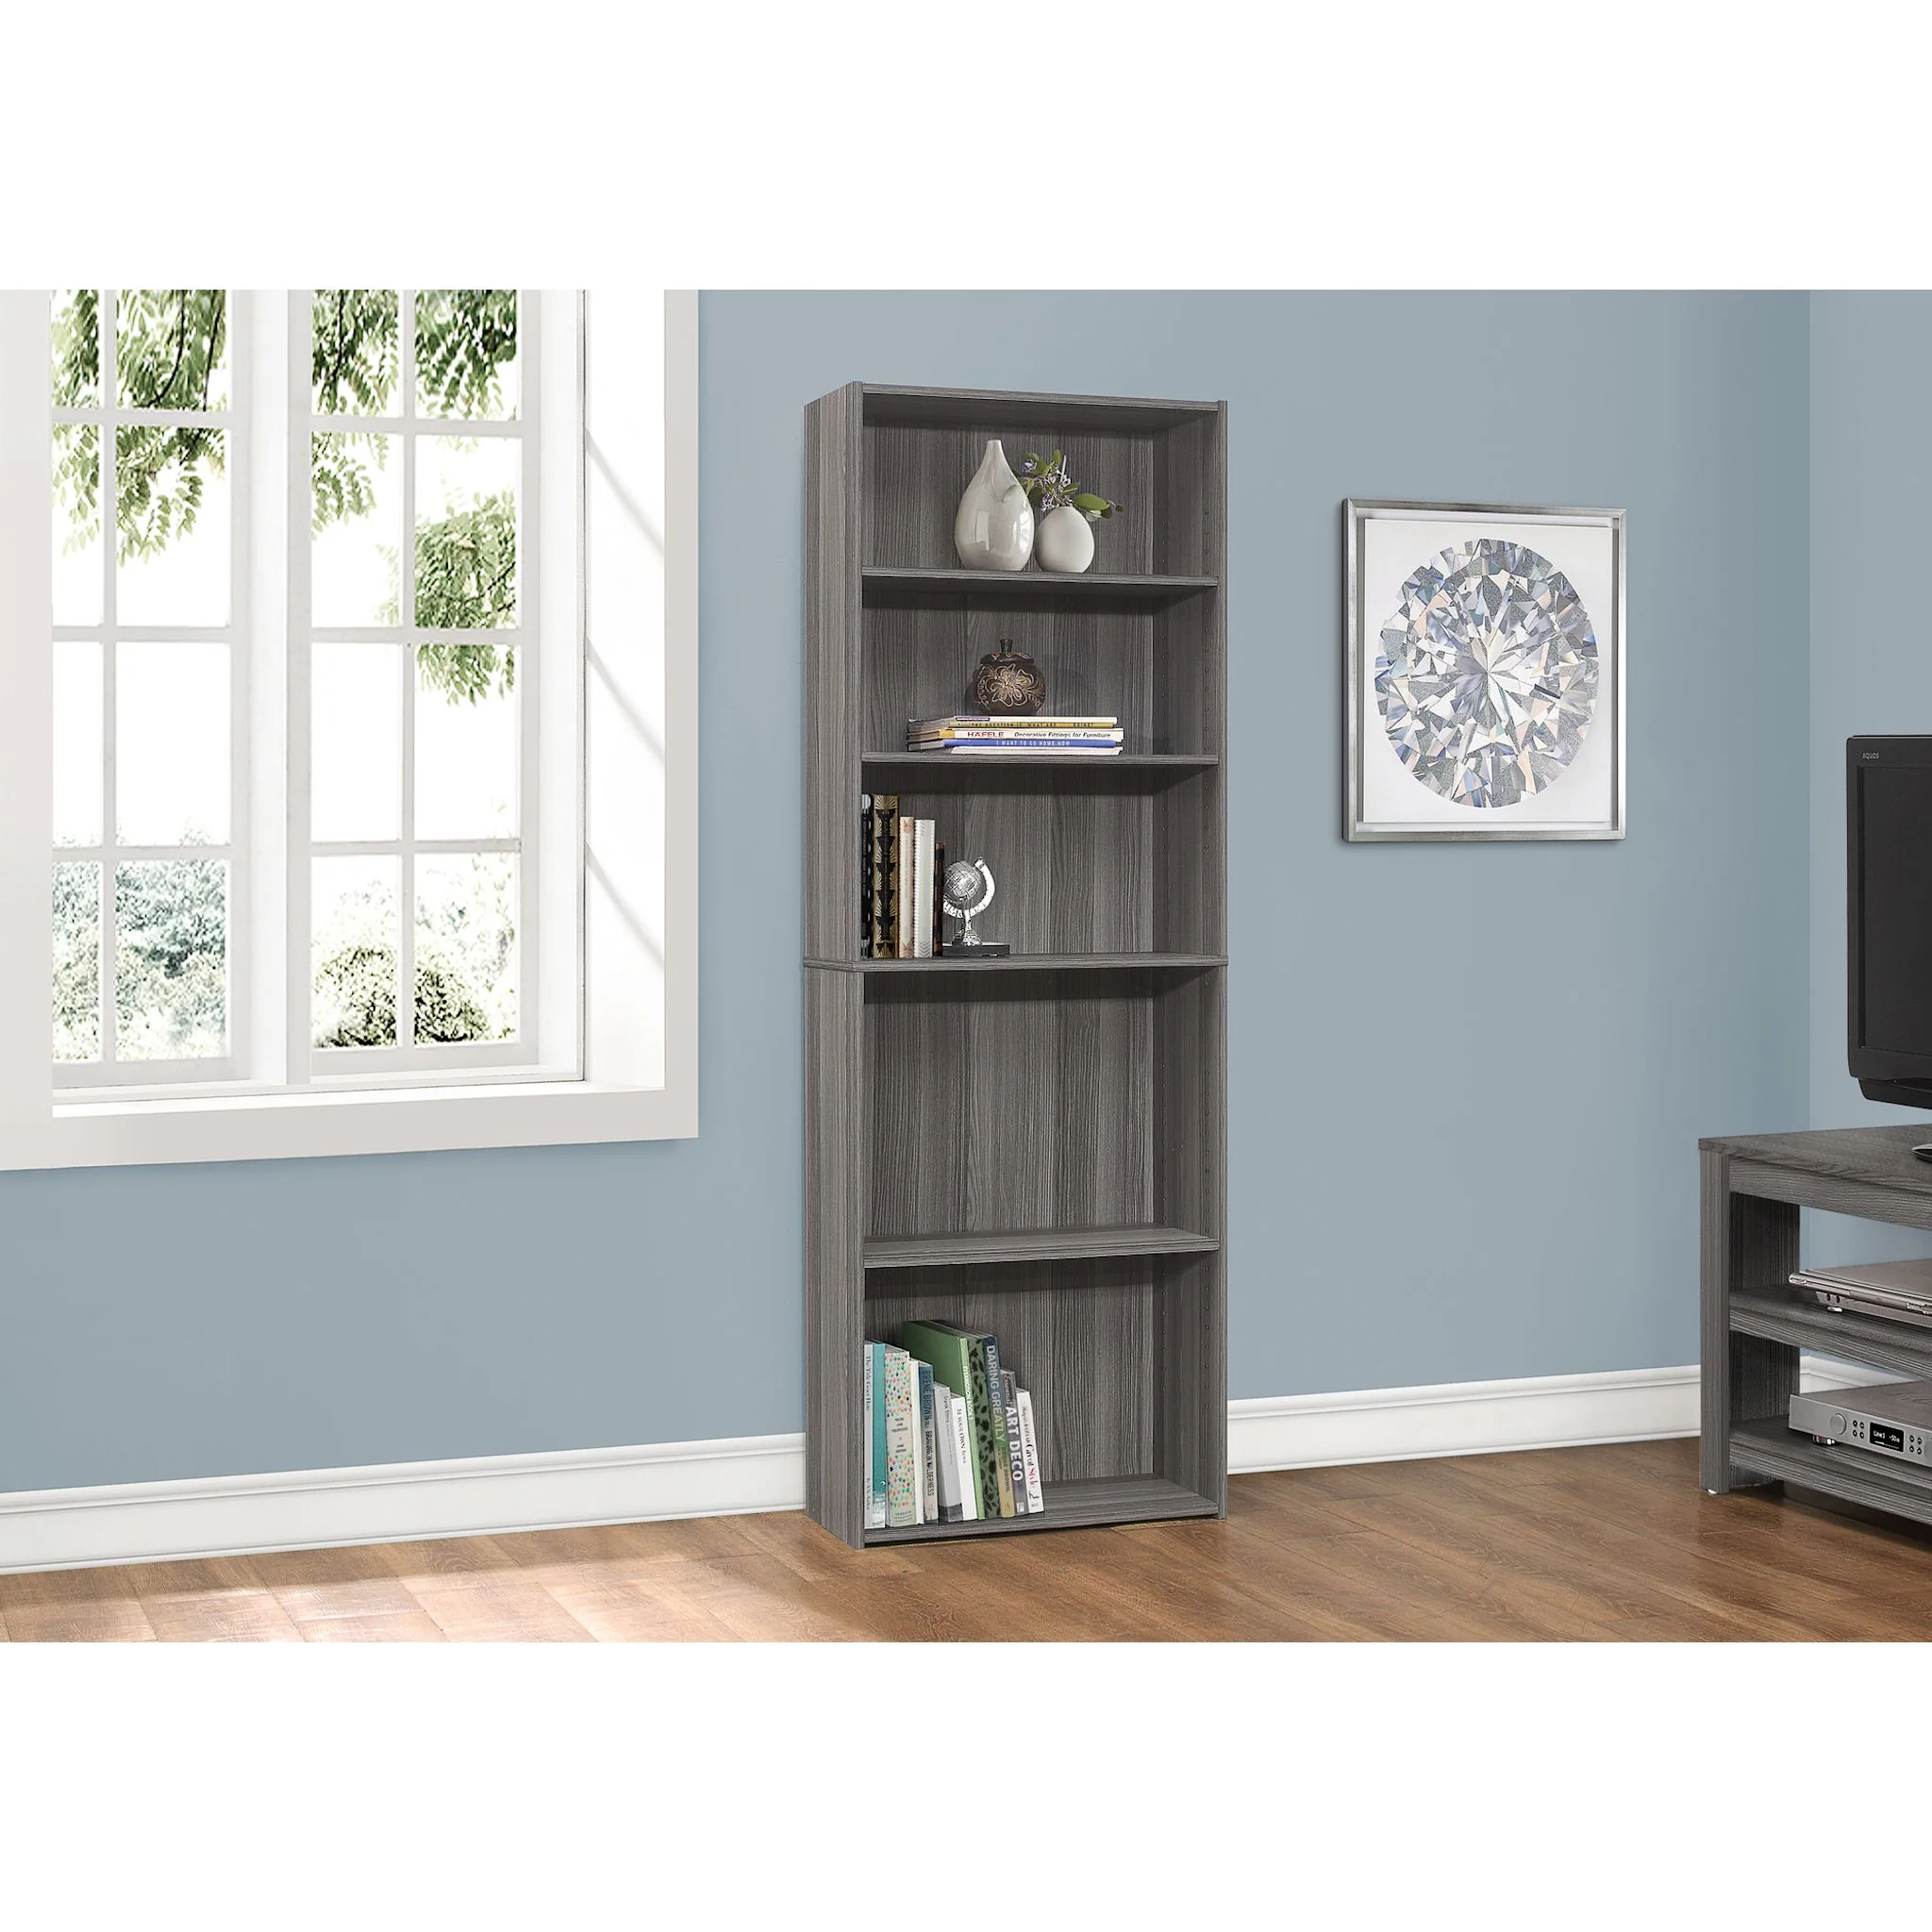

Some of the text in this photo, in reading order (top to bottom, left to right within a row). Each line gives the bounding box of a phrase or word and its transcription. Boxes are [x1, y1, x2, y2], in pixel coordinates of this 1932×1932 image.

[986, 1344, 1006, 1442] DARING GREATLY
[1003, 1374, 1024, 1481] Essential ART DECO
